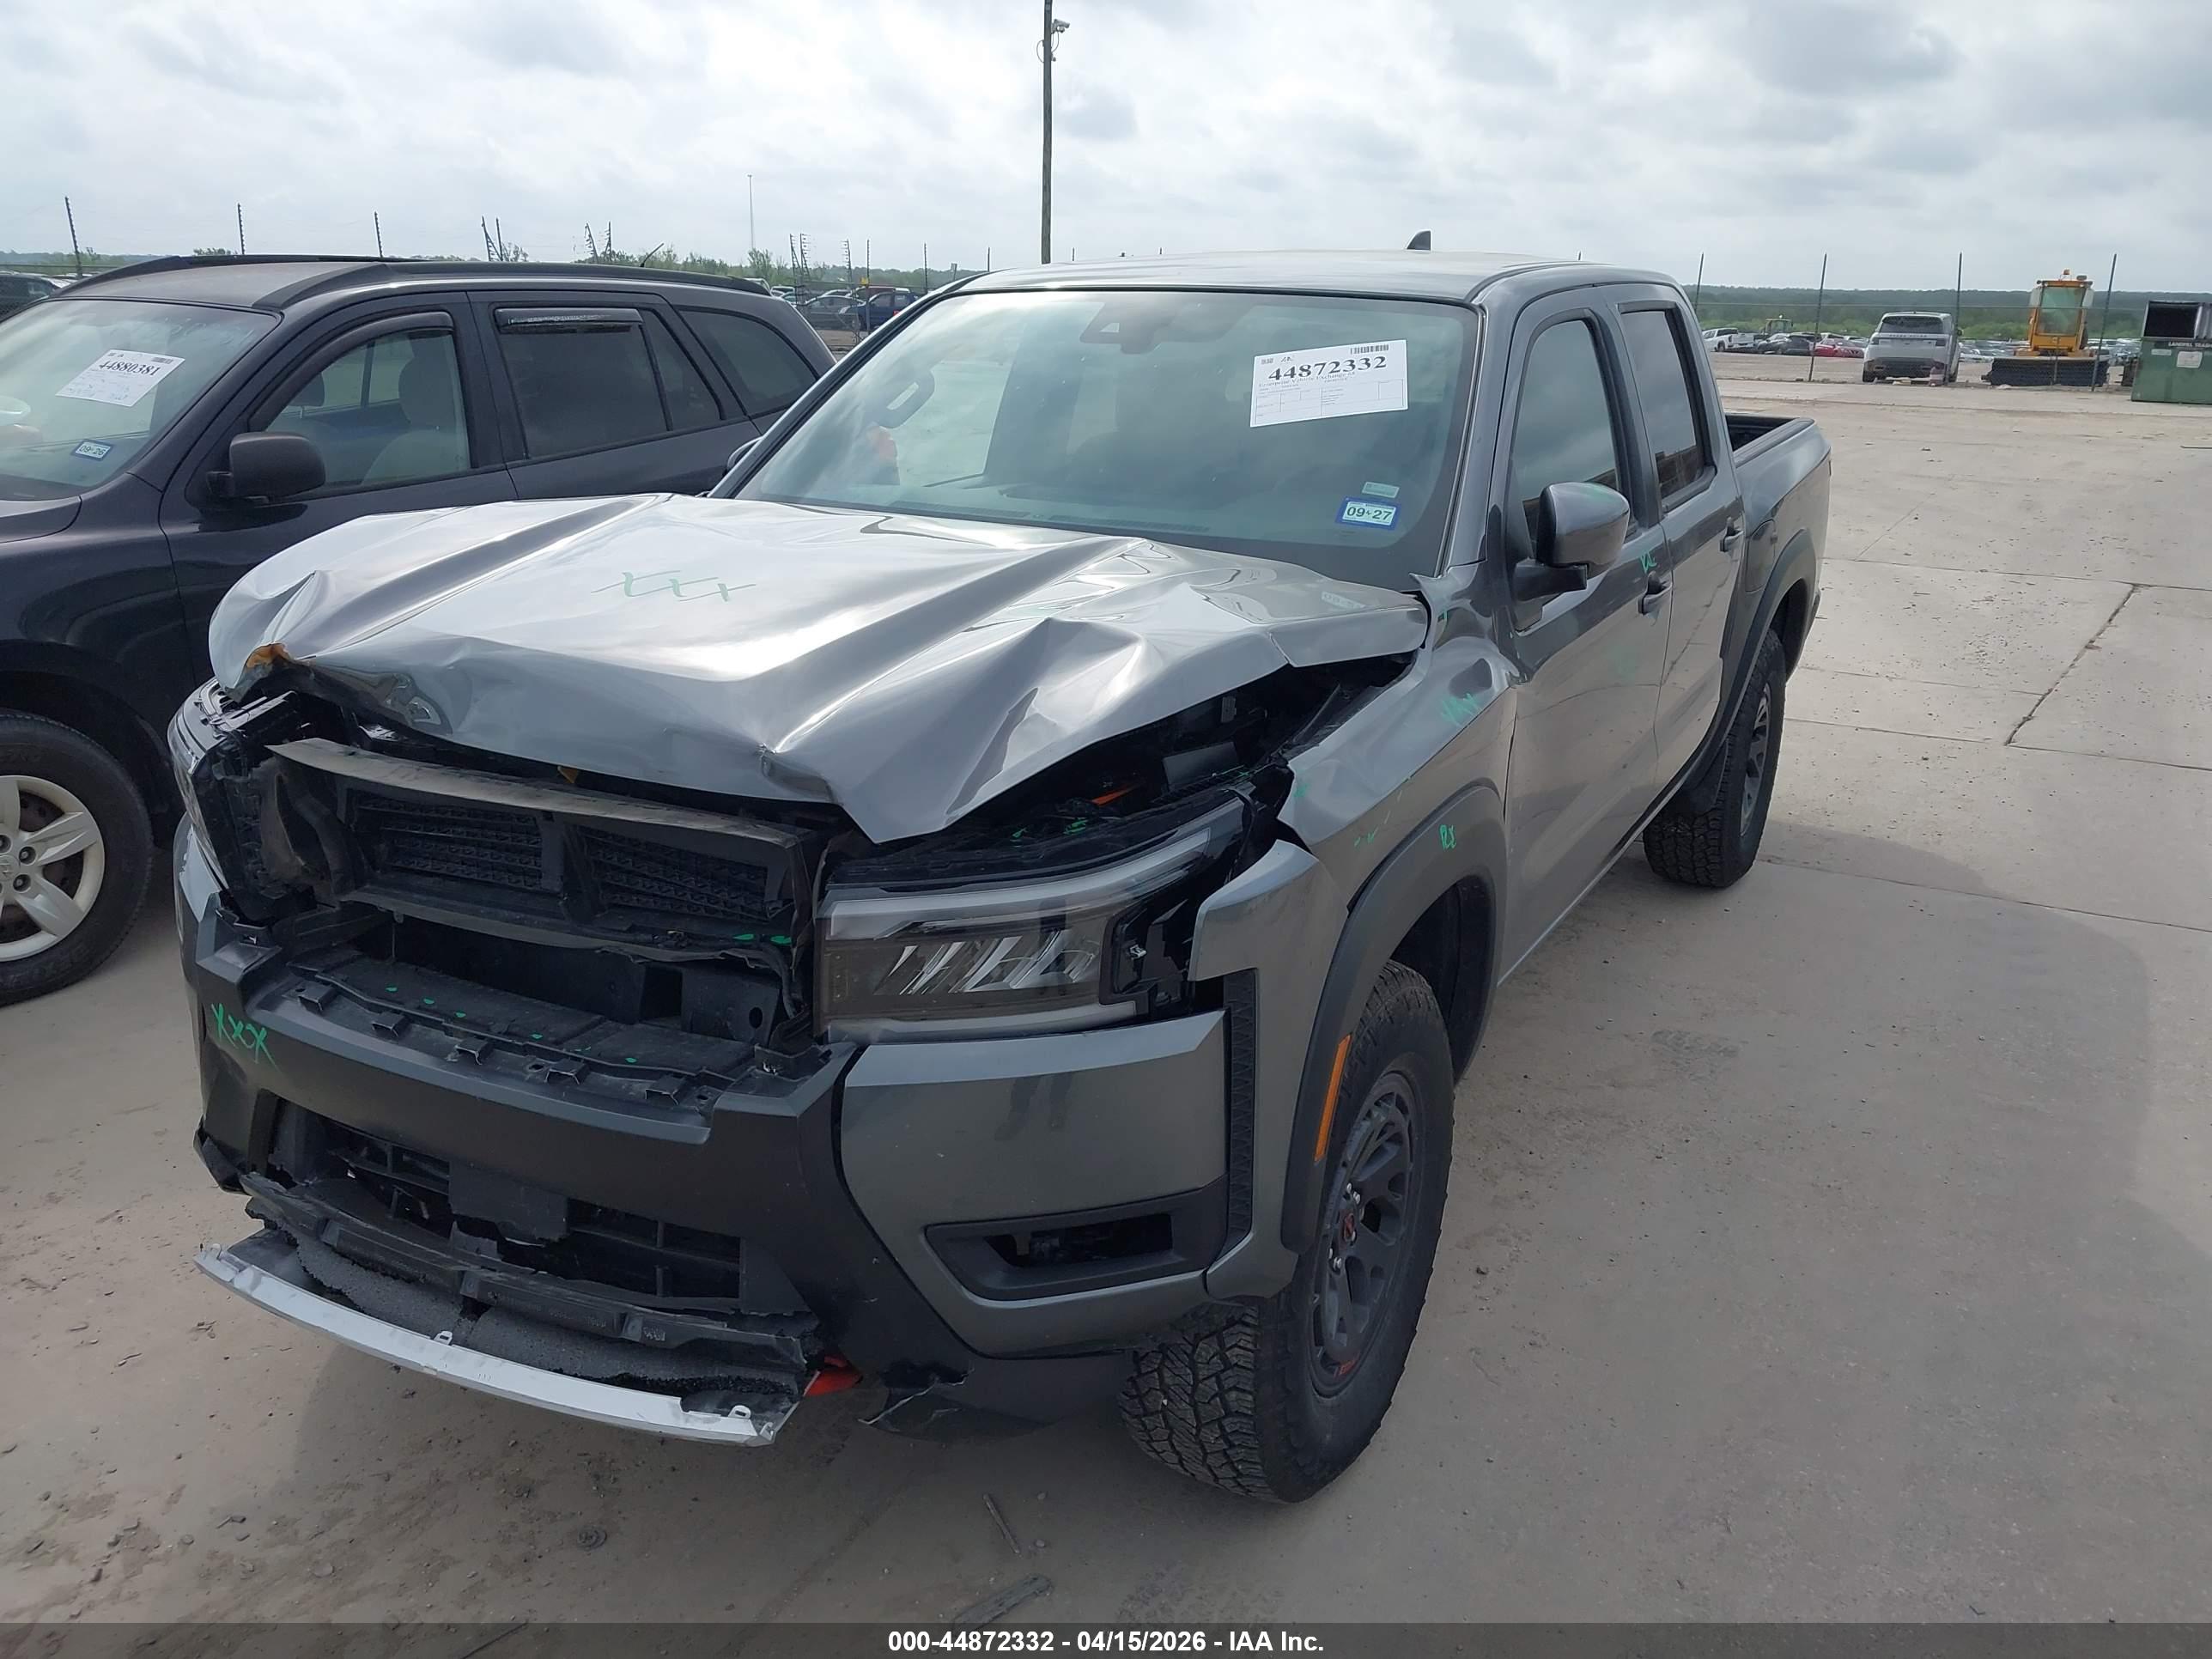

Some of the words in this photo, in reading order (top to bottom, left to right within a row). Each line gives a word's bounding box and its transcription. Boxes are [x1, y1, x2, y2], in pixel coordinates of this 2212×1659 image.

[99, 360, 161, 376] 44880381
[1268, 356, 1387, 380] 44872332
[1346, 507, 1365, 517] 09
[1372, 509, 1392, 520] 27
